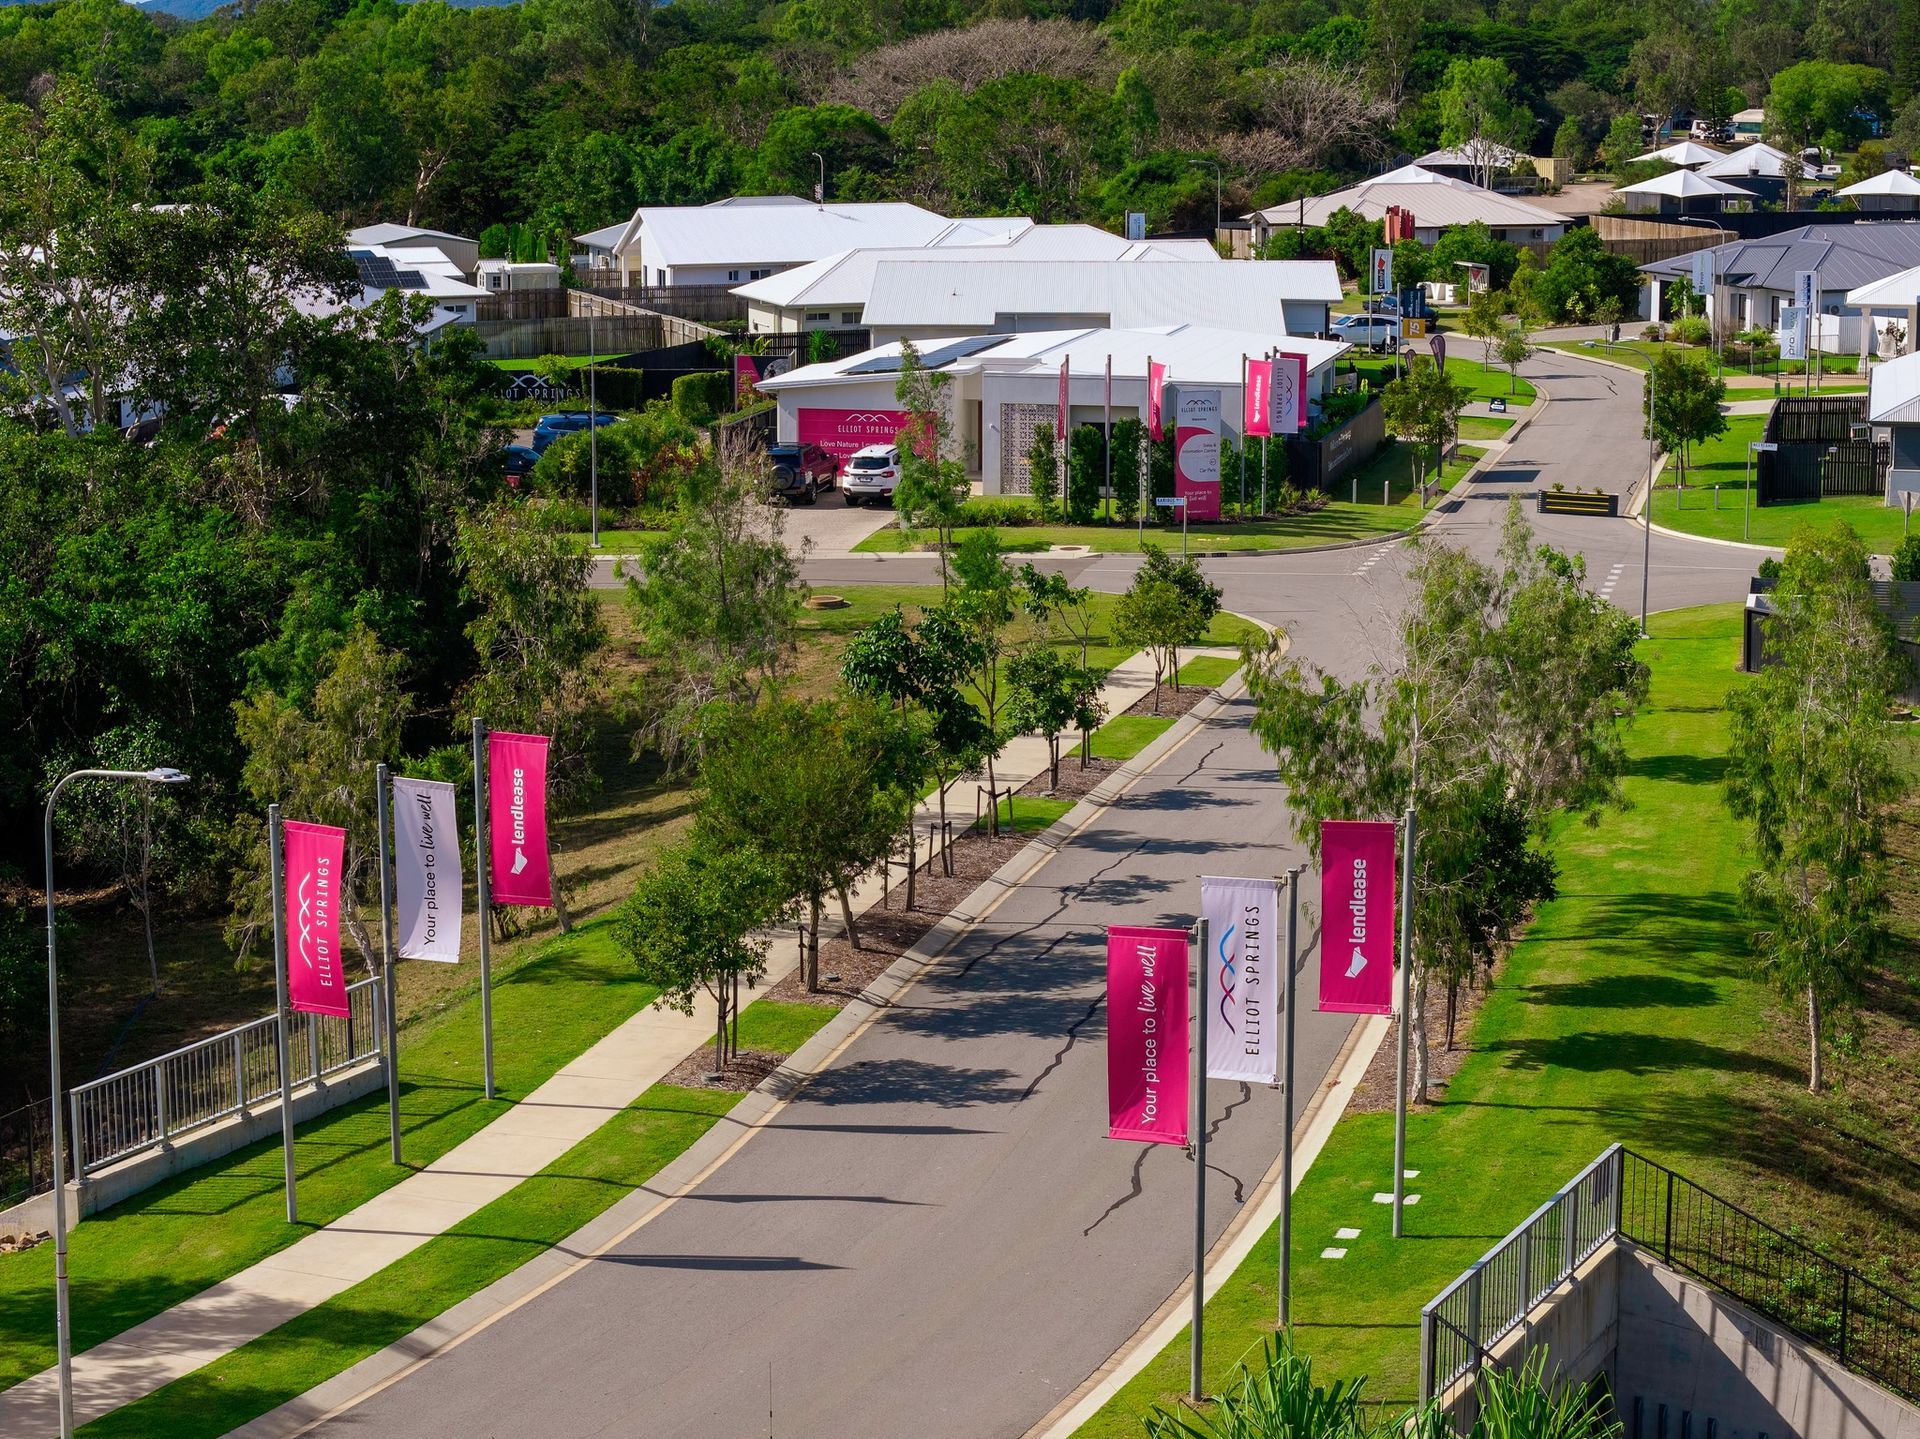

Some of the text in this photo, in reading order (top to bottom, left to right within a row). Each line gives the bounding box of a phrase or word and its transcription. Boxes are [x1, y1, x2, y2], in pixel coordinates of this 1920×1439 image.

[1409, 321, 1420, 336] 75
[527, 388, 581, 399] SPRINGS
[838, 425, 899, 434] ELLIOT SPRINGS
[511, 768, 525, 845] lendlease
[416, 793, 439, 946] Your place to live well
[1349, 858, 1367, 943] lendlease
[316, 857, 333, 987] ELLIOT SPRINGS
[1245, 906, 1260, 1055] ELLIOT SPRINGS
[1136, 945, 1161, 1124] Your place to live well
